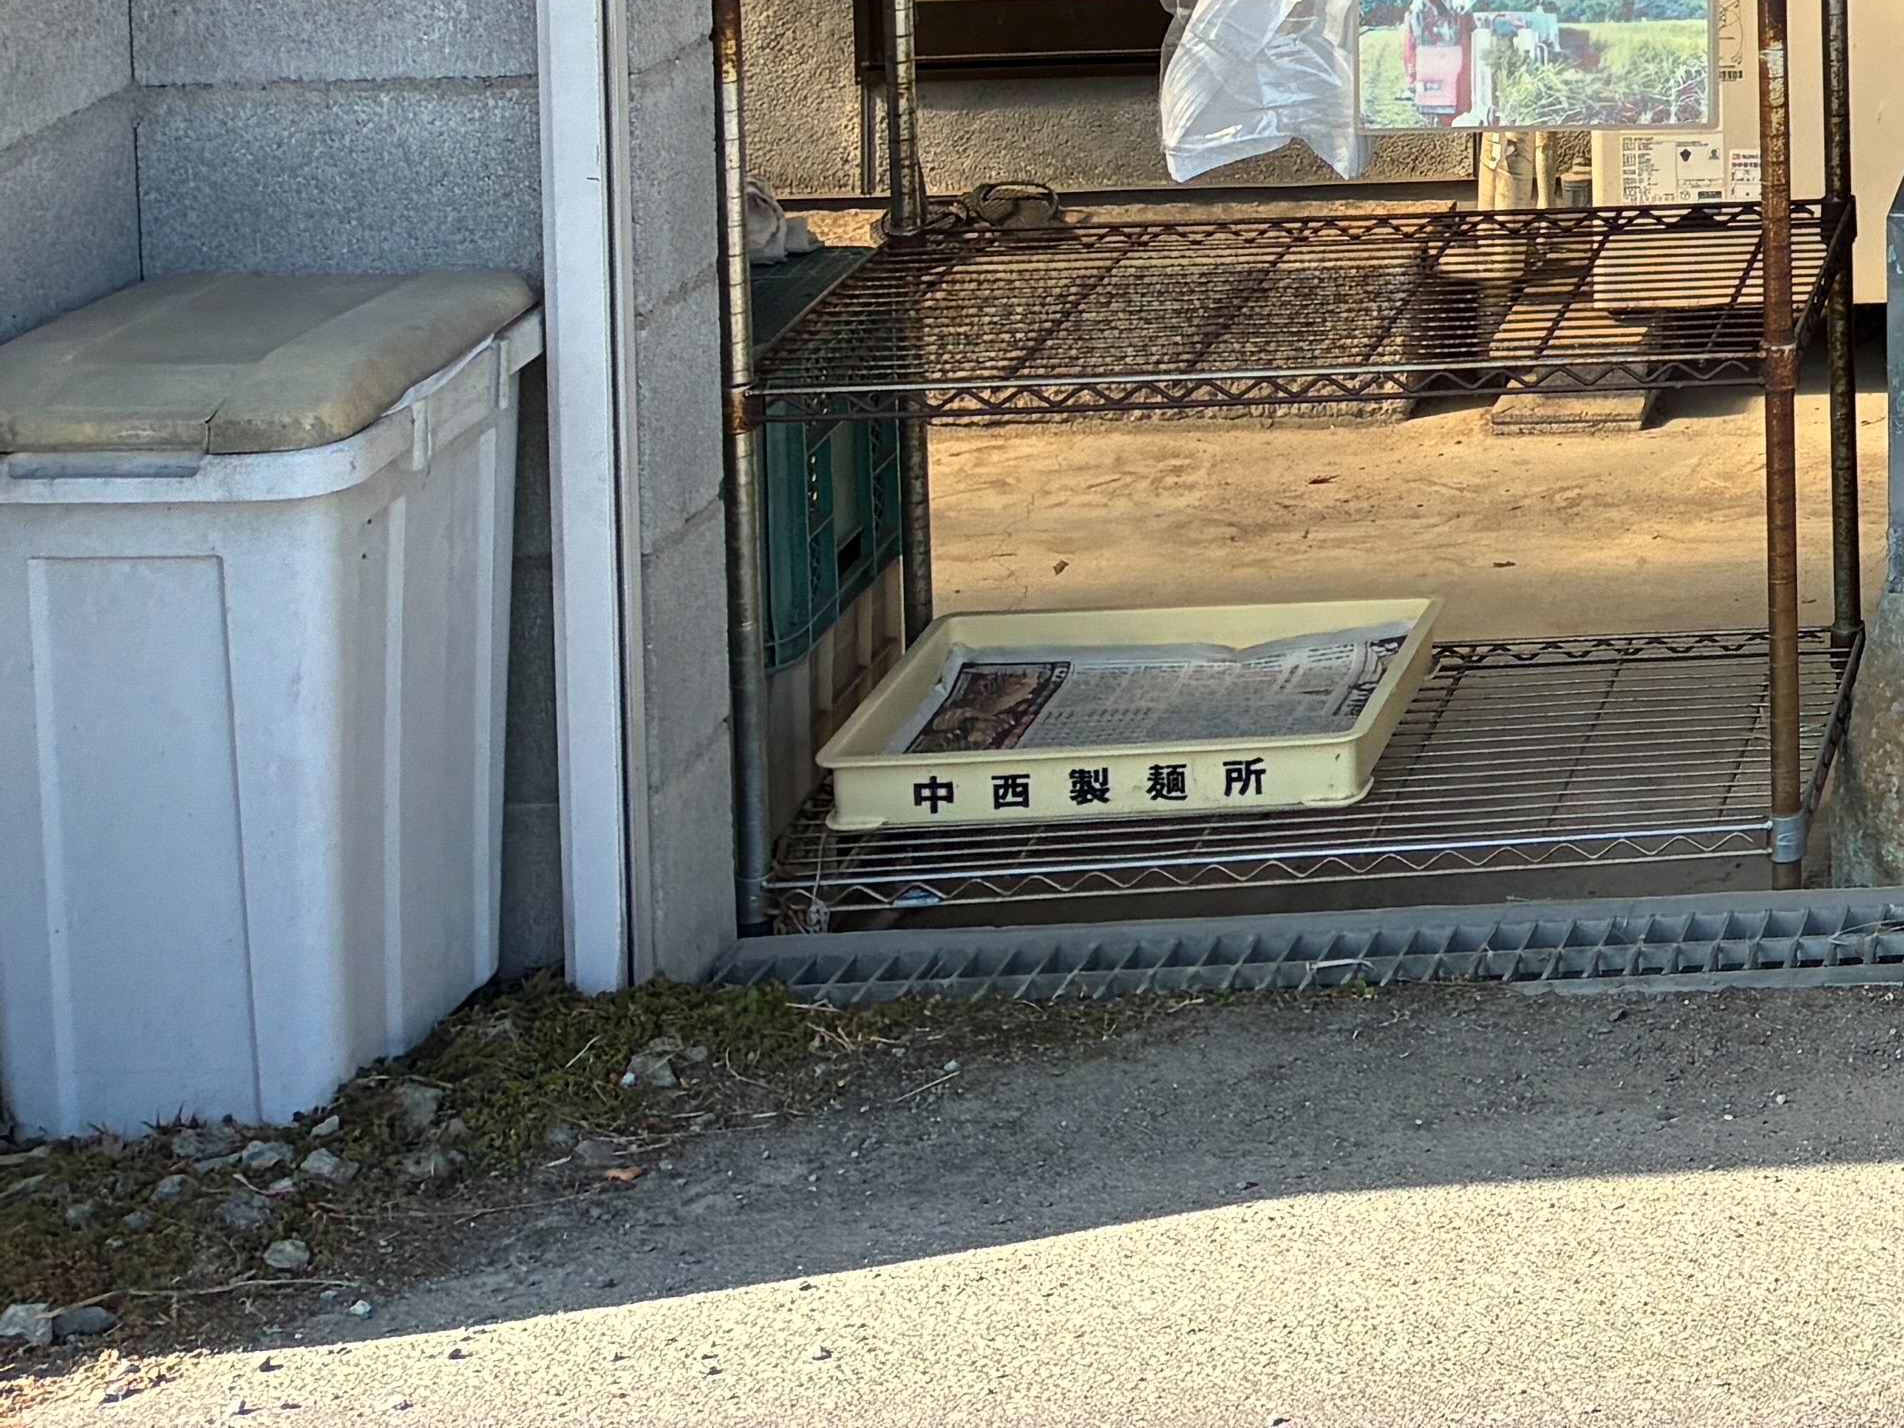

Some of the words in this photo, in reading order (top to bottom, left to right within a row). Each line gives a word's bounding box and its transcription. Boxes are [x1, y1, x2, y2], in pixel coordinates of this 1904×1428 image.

[913, 757, 1267, 814] 中西製麺所
